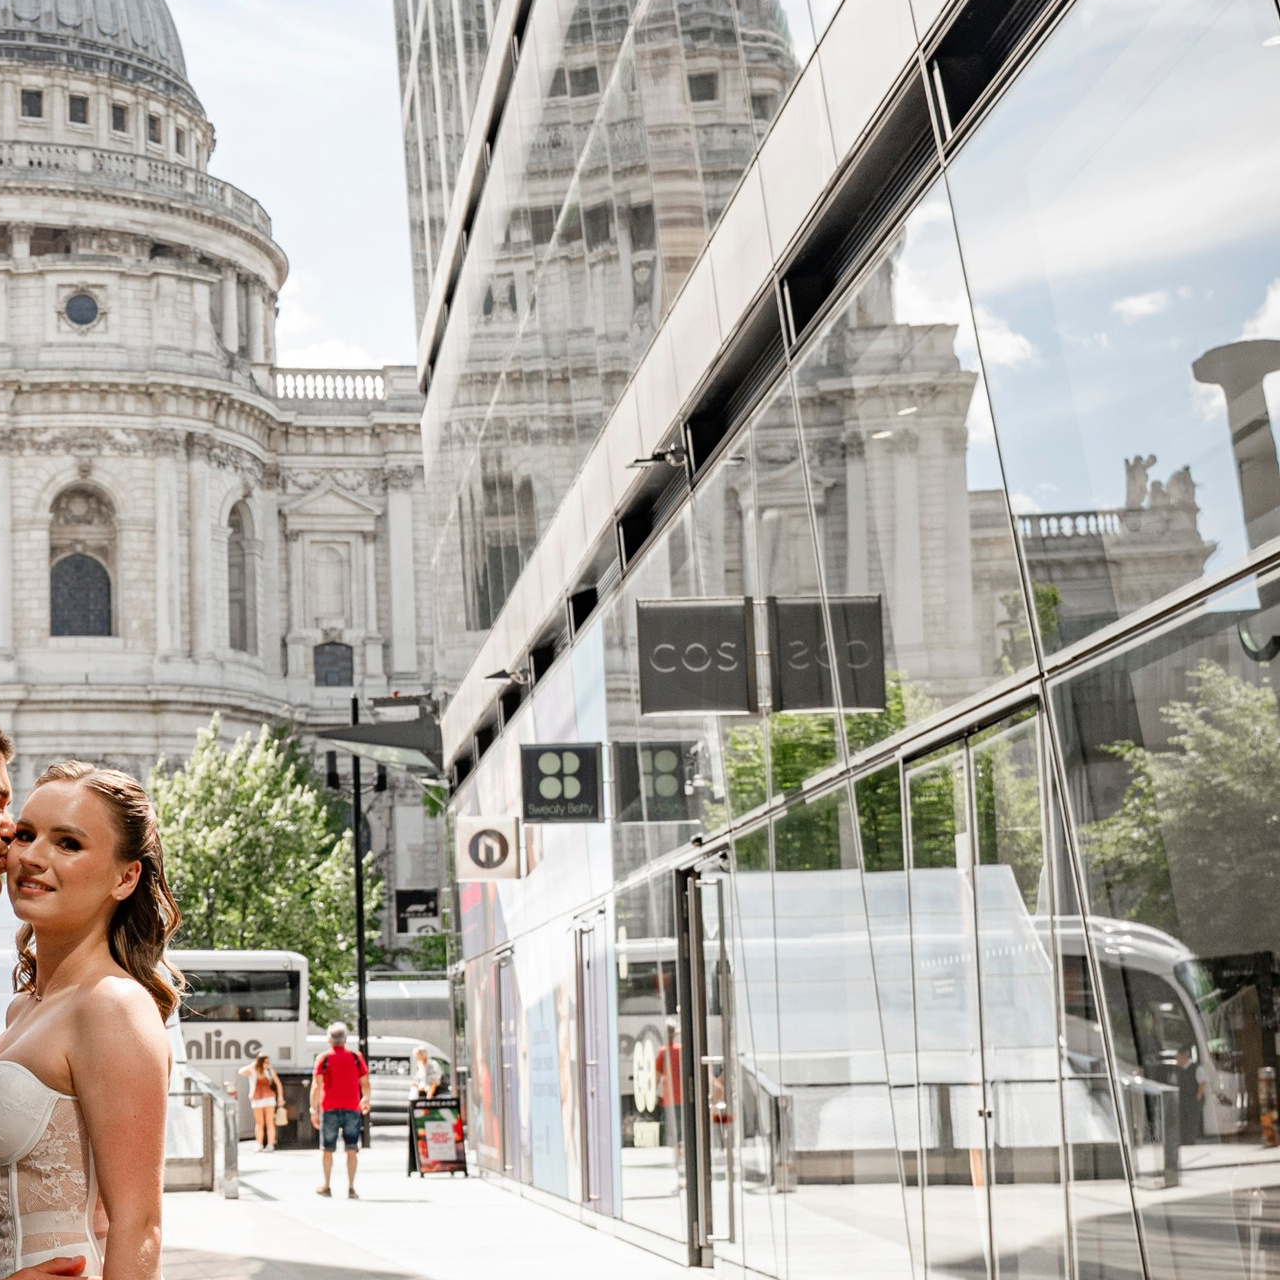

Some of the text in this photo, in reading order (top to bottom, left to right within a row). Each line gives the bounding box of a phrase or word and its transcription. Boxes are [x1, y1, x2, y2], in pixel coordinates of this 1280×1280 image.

[649, 641, 739, 673] COS
[185, 1028, 263, 1060] nline
[368, 1057, 411, 1074] prise
